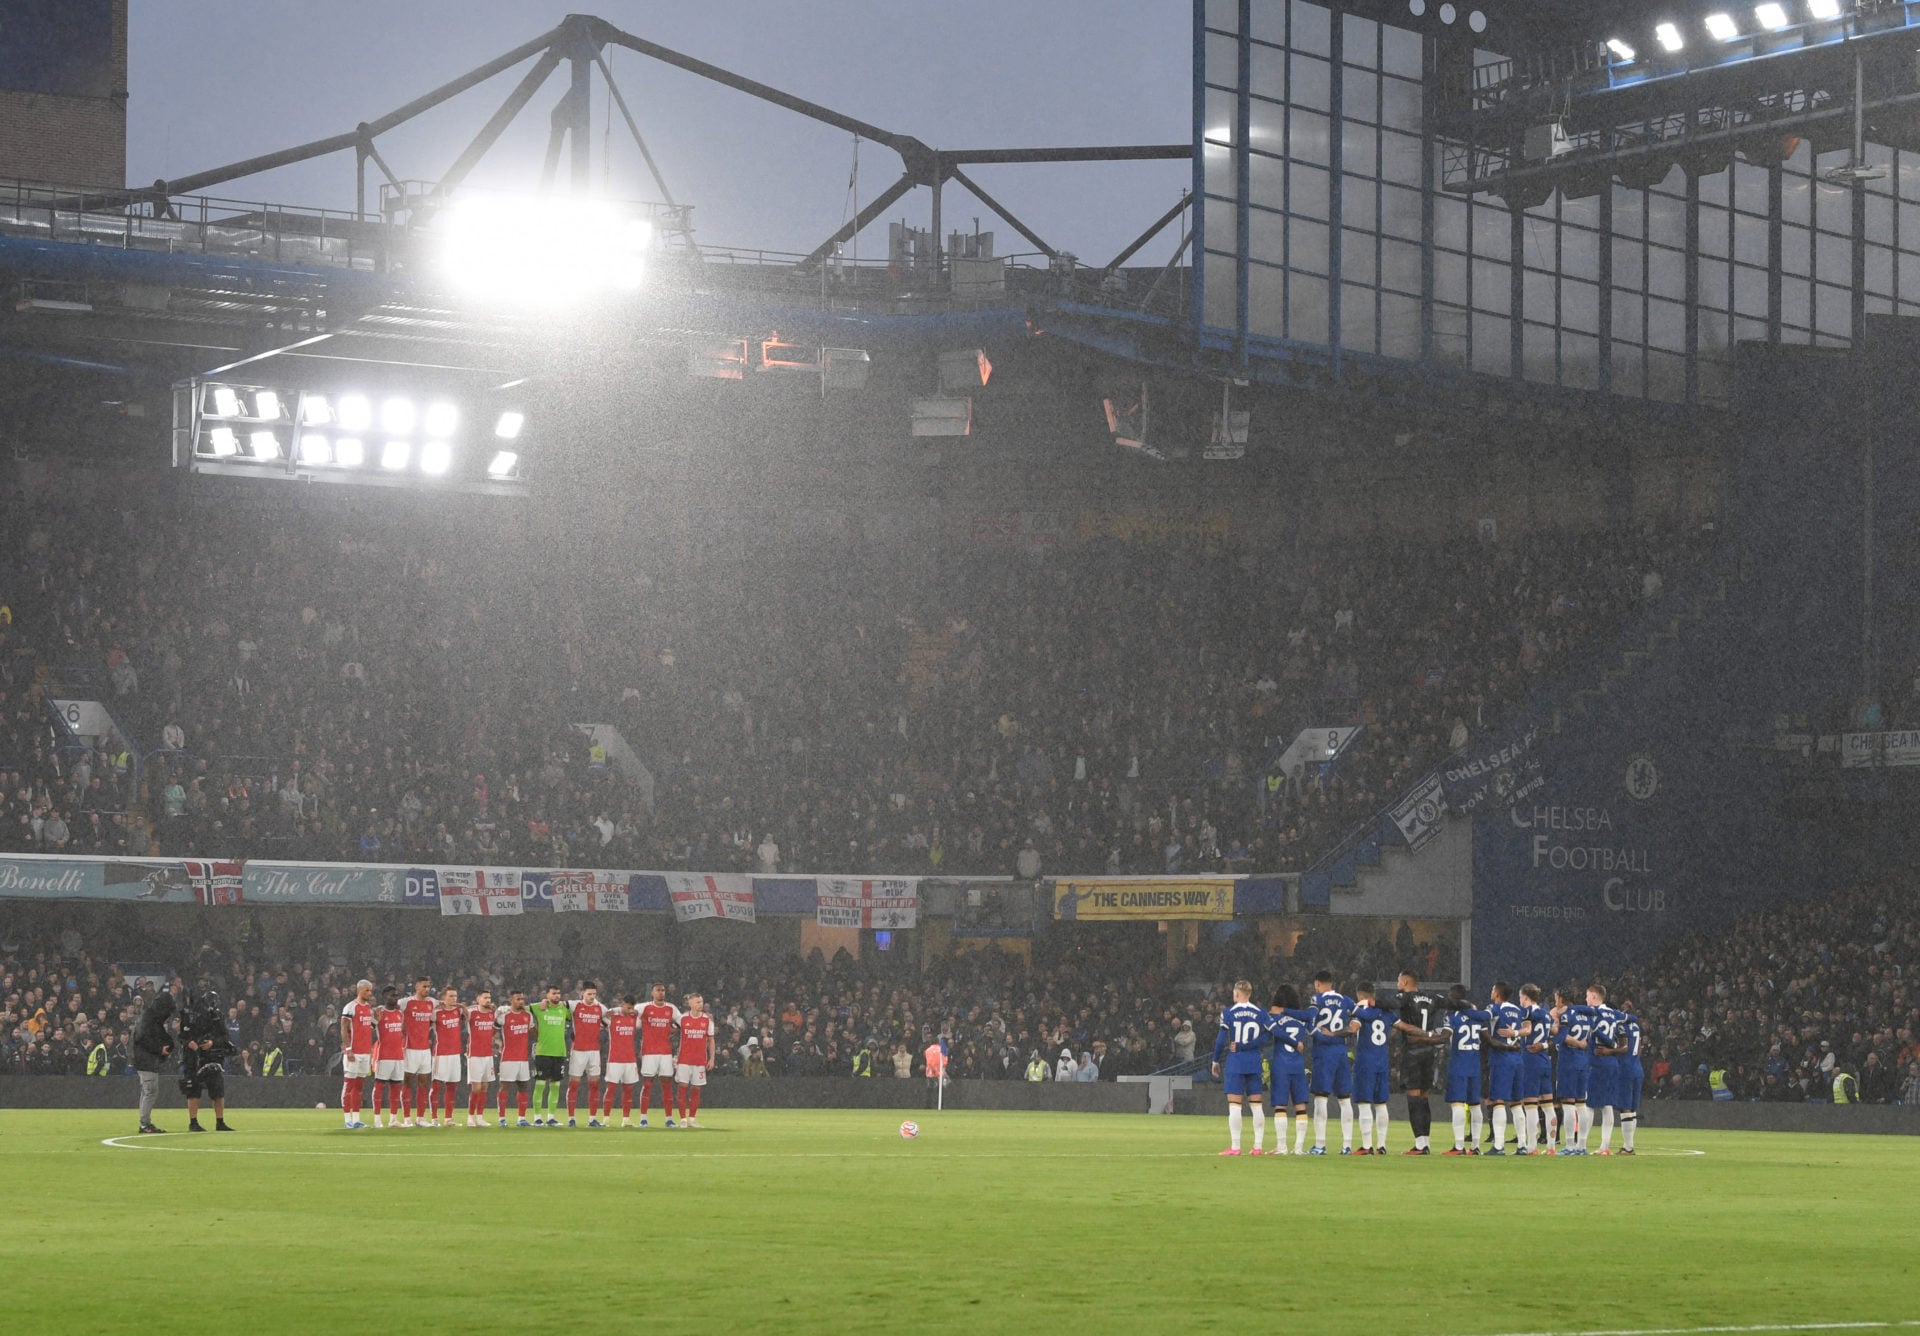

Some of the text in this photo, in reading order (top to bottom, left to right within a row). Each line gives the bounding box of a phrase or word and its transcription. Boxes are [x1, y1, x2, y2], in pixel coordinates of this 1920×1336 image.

[67, 703, 81, 723] 6
[1328, 730, 1338, 749] 8
[1446, 743, 1522, 782] CHELSEA
[1459, 785, 1488, 814] TONY
[1511, 806, 1613, 832] CHELSEA
[1533, 835, 1653, 872] FOOTBALL
[0, 864, 85, 892] Bonetti
[556, 883, 625, 894] CHELSEA FC
[461, 887, 506, 897] CHELSEA FC
[713, 891, 736, 900] RICE
[1093, 891, 1210, 907] THE CANNERS WAY
[1603, 877, 1666, 912] CLUB
[681, 903, 711, 915] 1971
[727, 904, 753, 916] 2008
[1510, 905, 1585, 920] THE SHED END
[1317, 1008, 1344, 1033] 26
[1420, 1008, 1429, 1032] 1
[1233, 1021, 1260, 1045] 10
[1371, 1019, 1387, 1046] 8
[1458, 1024, 1481, 1051] 25
[1571, 1024, 1590, 1041] 27
